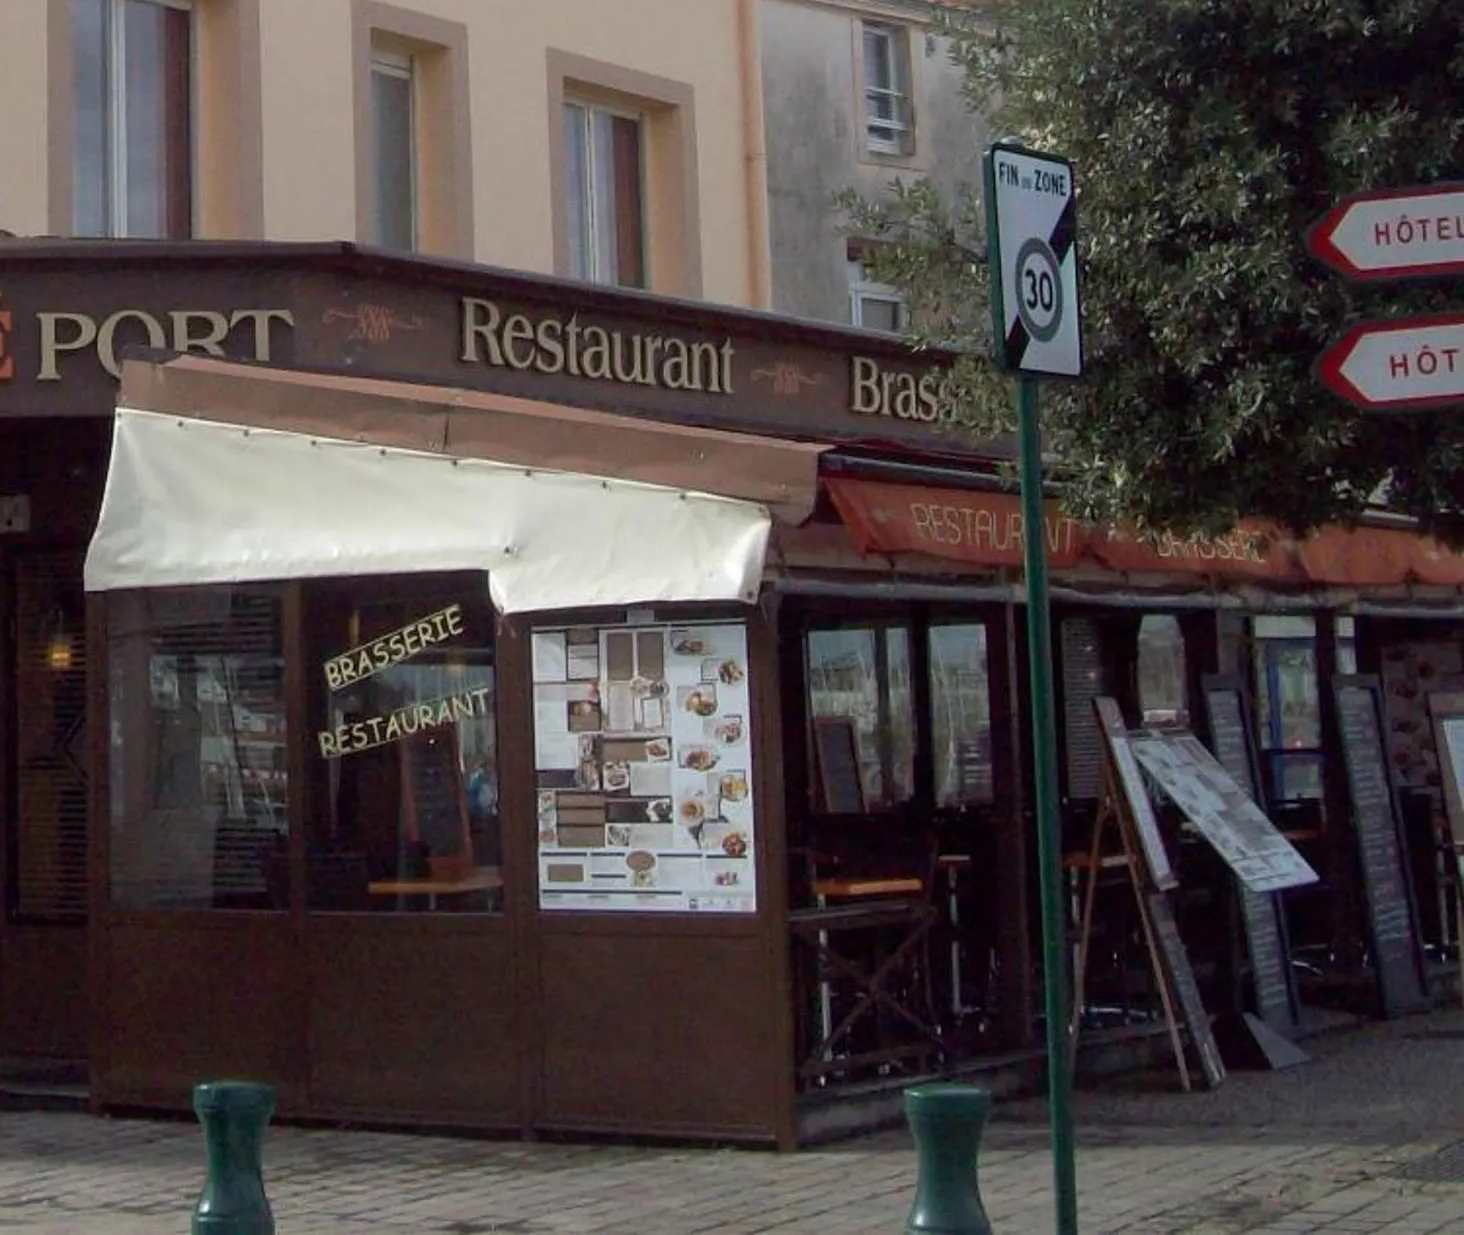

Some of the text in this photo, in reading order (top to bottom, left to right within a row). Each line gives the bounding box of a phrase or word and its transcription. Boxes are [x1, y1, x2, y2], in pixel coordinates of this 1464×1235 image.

[998, 162, 1019, 186] FIN
[1034, 169, 1067, 197] ZONE
[1023, 267, 1054, 314] 30
[38, 309, 294, 381] PORT
[461, 296, 735, 393] Restaurant
[324, 605, 464, 689] BRASSERIE
[318, 687, 489, 758] RESTAURANT
